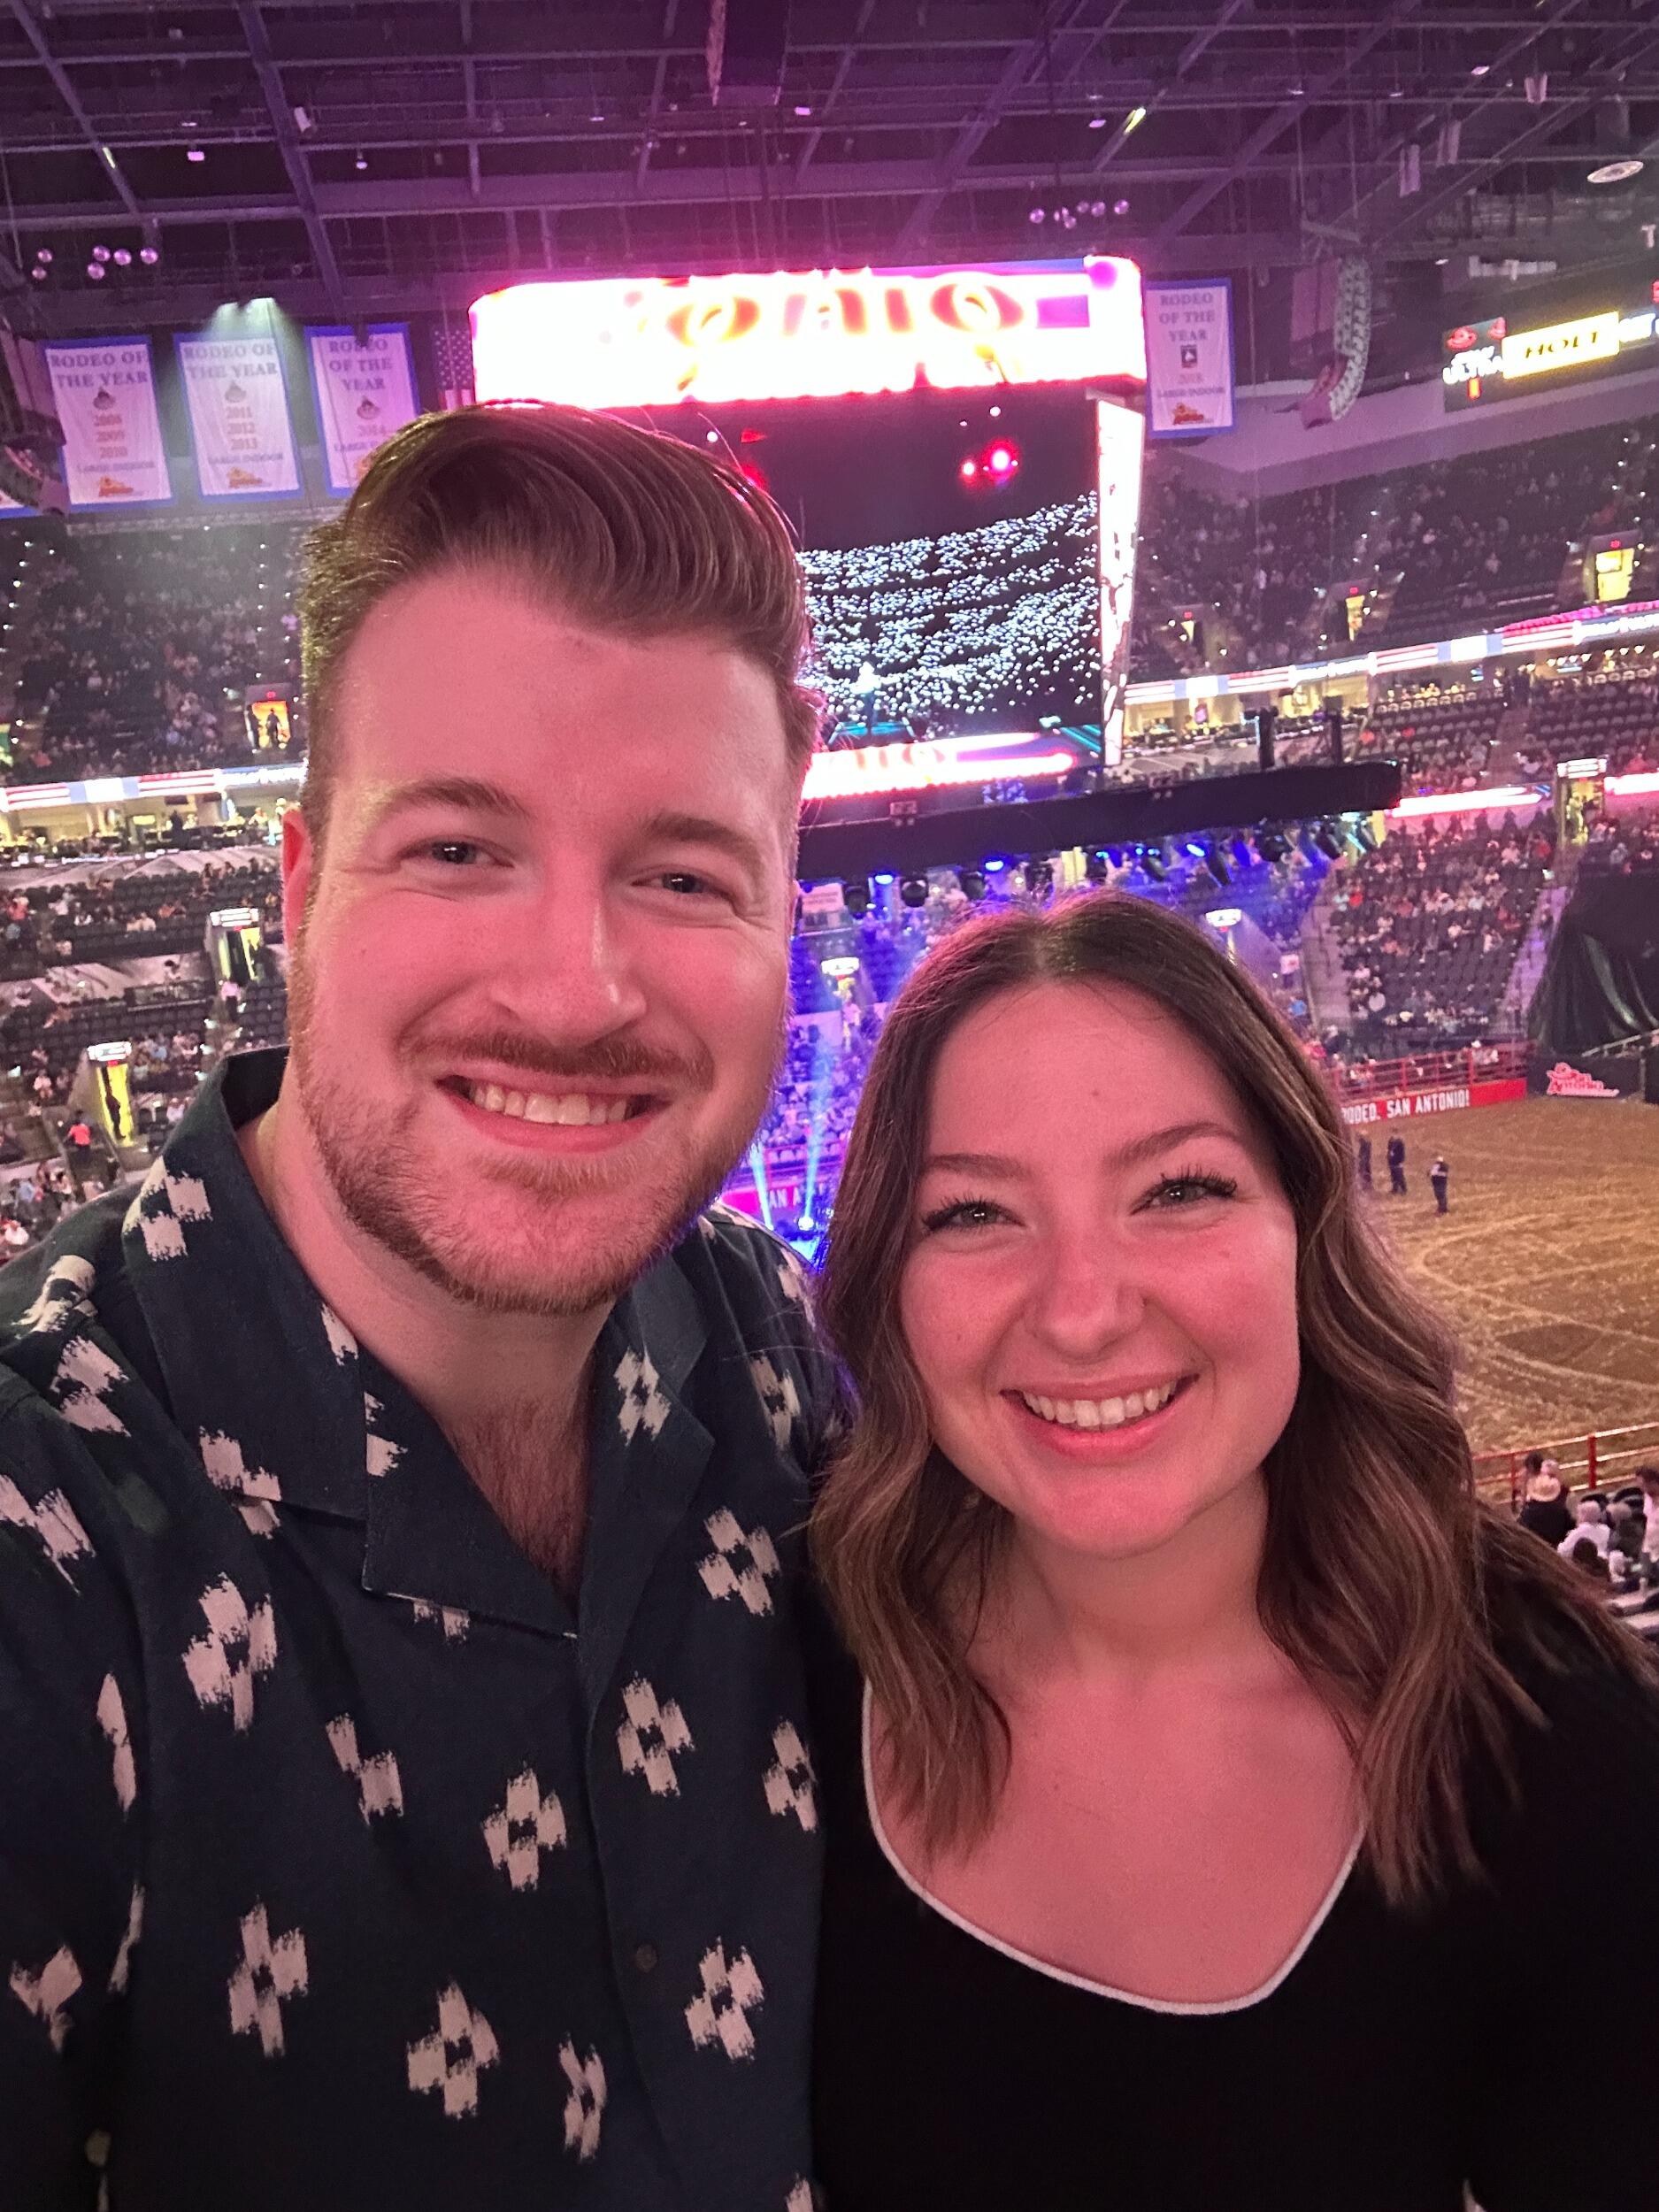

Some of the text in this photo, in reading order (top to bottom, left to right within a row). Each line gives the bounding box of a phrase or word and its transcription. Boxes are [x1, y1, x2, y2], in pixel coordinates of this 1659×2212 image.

[1160, 293, 1214, 305] RODEO
[1159, 310, 1215, 325] OF THE
[1169, 330, 1208, 342] YEAR
[183, 343, 276, 359] RODEO OF
[1524, 331, 1599, 359] HOLT
[50, 351, 148, 368] RODEO OF
[329, 358, 394, 373] OF THE
[186, 362, 279, 380] THE YEAR
[56, 372, 148, 388] THE YEAR
[342, 378, 386, 391] YEAR
[226, 406, 253, 419] 2011
[227, 421, 257, 434] 2012
[230, 438, 259, 450] 2013
[1386, 1098, 1411, 1119] SAN
[1415, 1089, 1471, 1114] ANTONIO!
